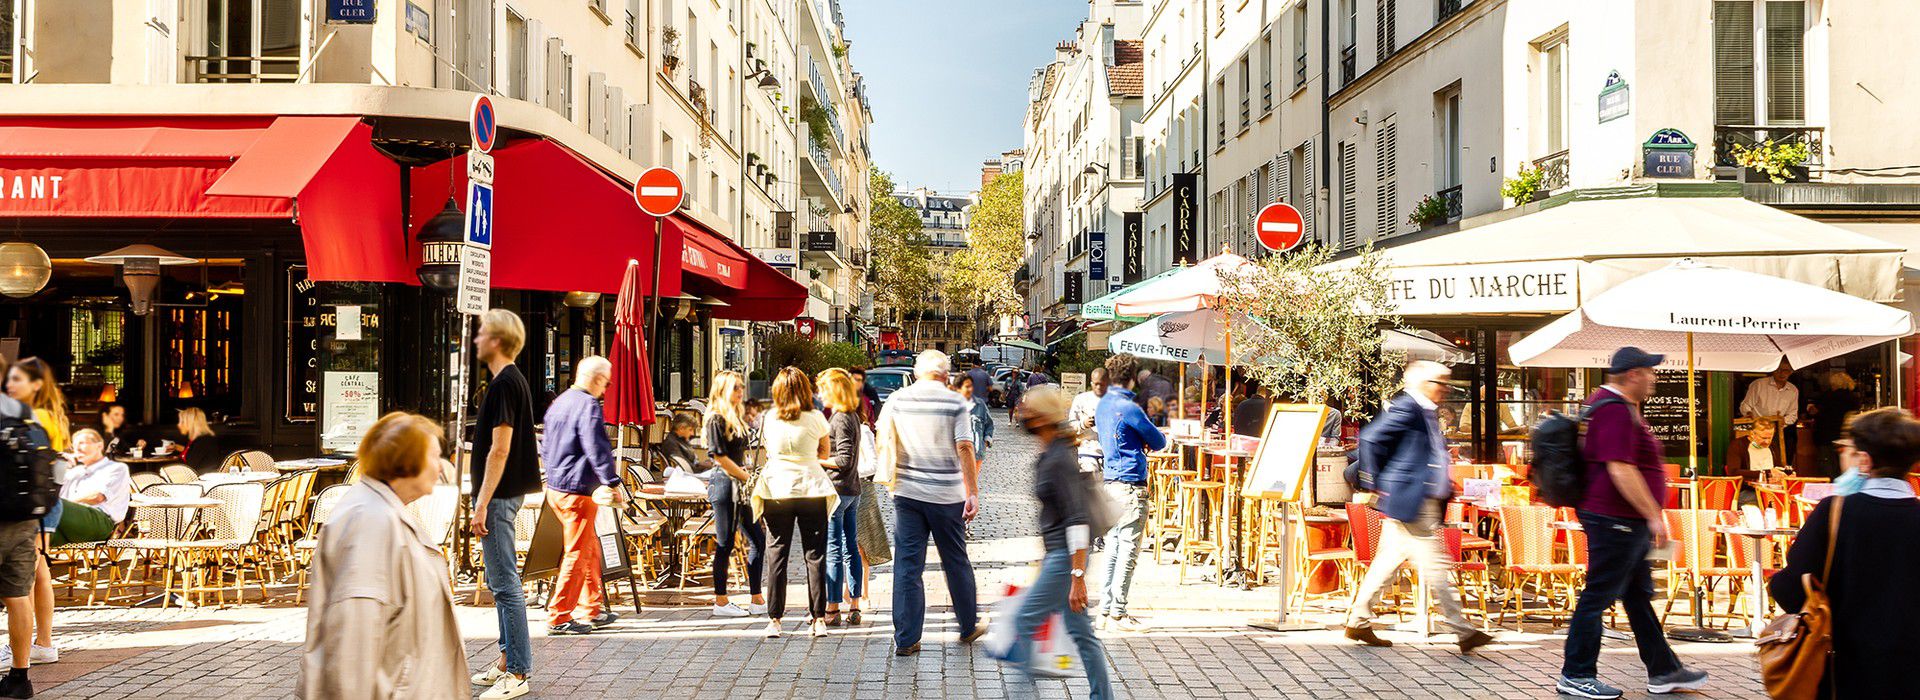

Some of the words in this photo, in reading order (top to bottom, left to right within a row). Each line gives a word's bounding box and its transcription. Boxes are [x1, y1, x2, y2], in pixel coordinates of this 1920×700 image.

[340, 9, 365, 17] CLER
[1659, 155, 1680, 163] RUE
[1656, 165, 1682, 173] CLER
[1179, 186, 1190, 252] CADRAN
[1128, 223, 1138, 275] CADRAN
[1391, 279, 1416, 300] FE
[1429, 278, 1455, 299] DU
[1469, 273, 1567, 298] MARCHE
[1669, 312, 1801, 331] Laurent-Perrier
[1120, 340, 1189, 359] FEVER-TREE
[340, 390, 362, 398] -50%
